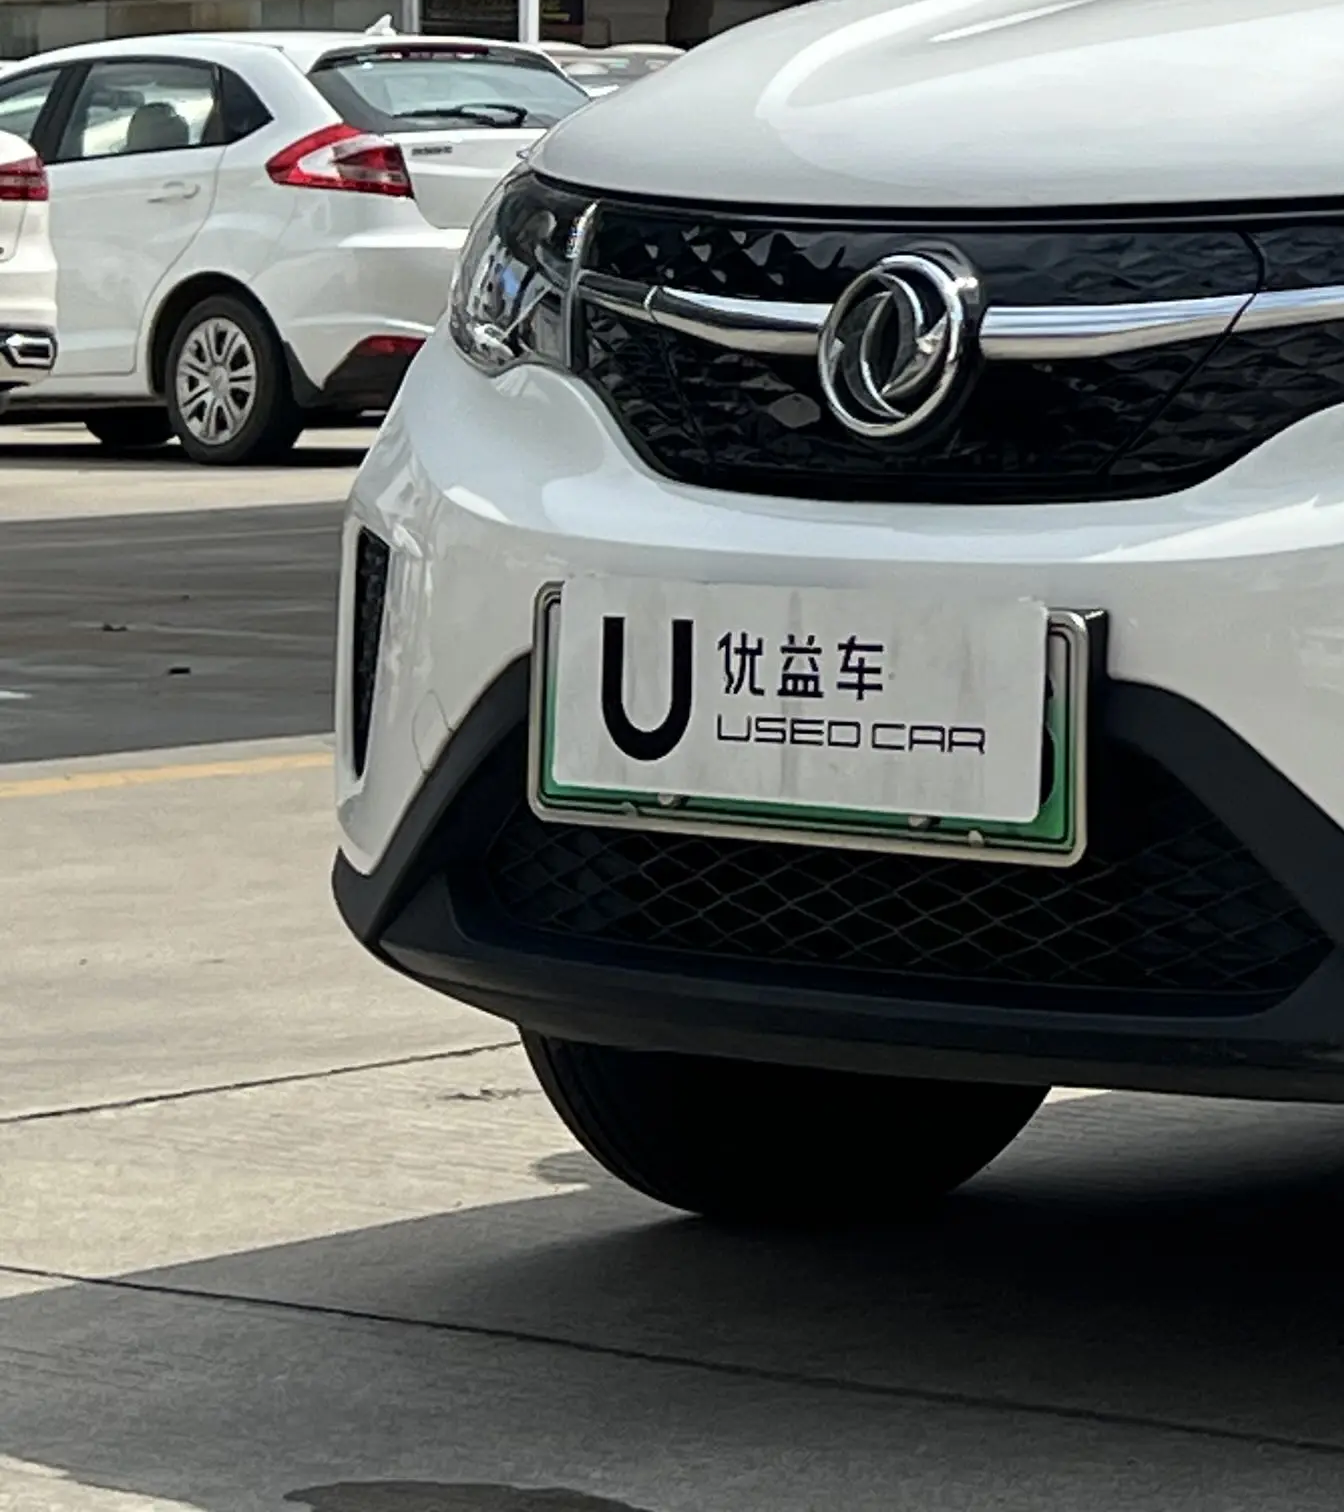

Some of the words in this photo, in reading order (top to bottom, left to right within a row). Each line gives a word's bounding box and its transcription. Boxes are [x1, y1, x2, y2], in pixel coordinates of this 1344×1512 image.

[716, 630, 885, 701] 优益车
[716, 713, 862, 750] USED
[870, 722, 986, 756] CAR
